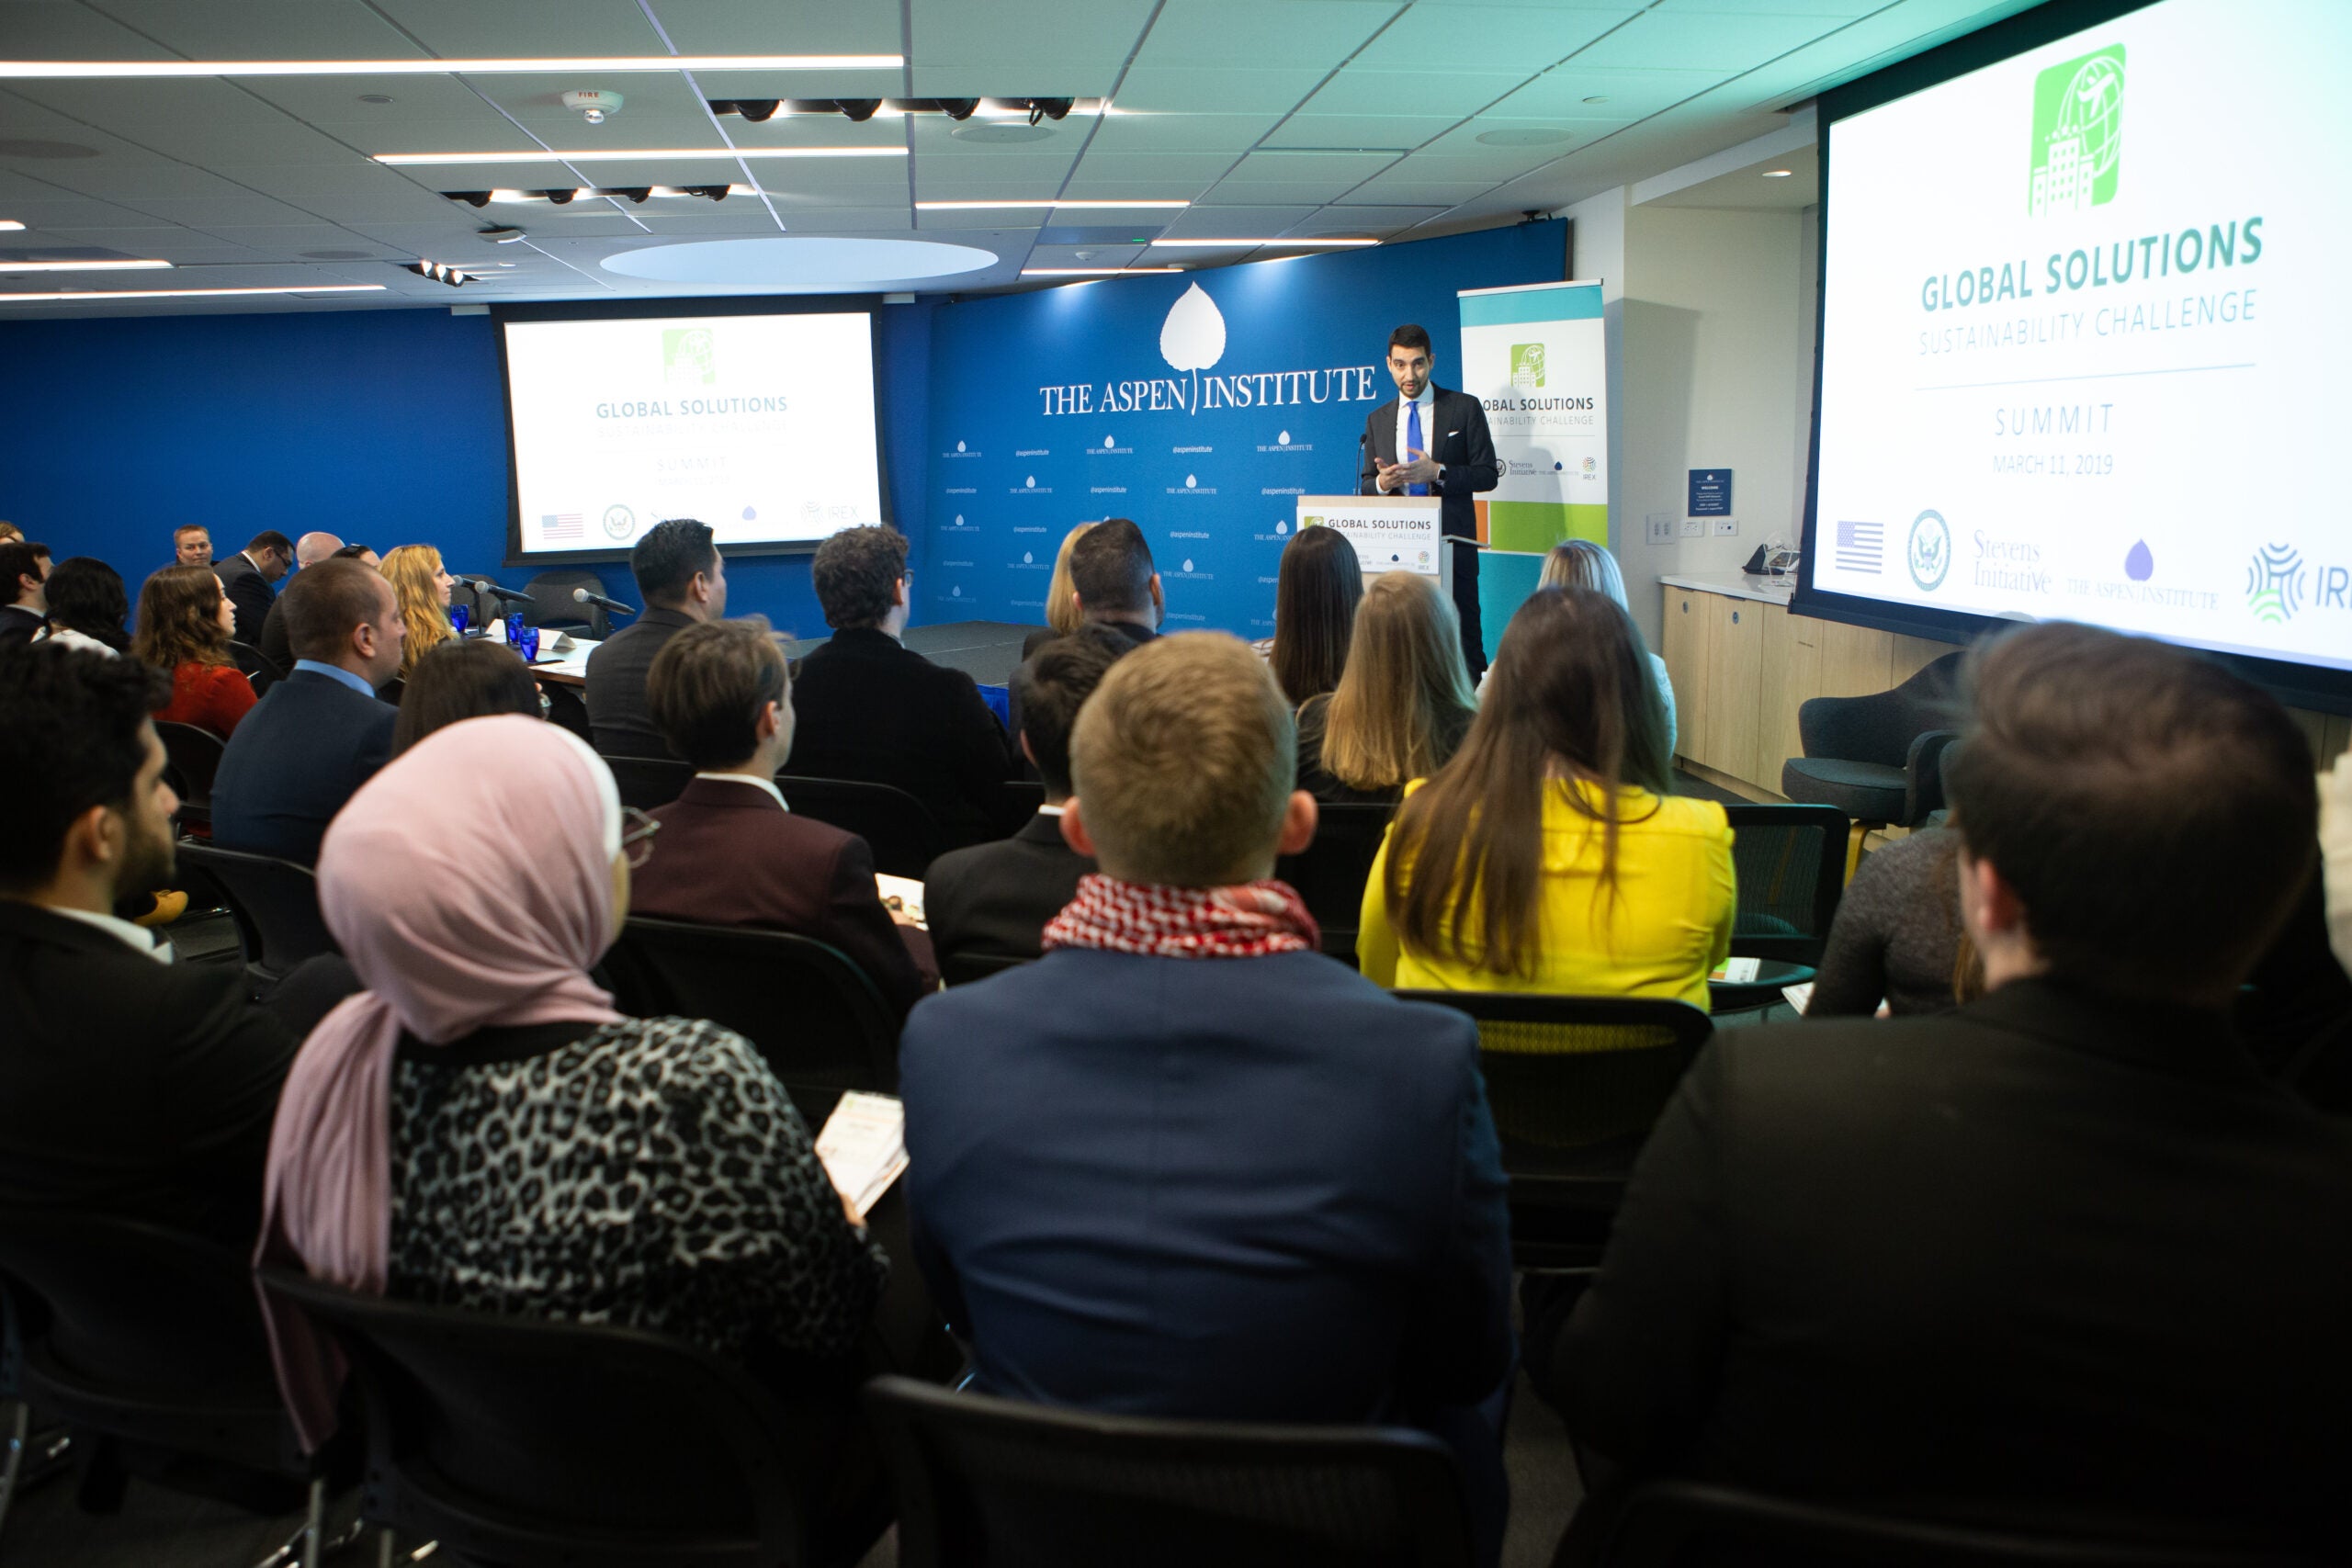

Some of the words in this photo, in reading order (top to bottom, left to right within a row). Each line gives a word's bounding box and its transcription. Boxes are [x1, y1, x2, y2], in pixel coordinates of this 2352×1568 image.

[1921, 259, 2033, 312] GLOBAL
[2045, 216, 2264, 295] SOLUTIONS
[1918, 310, 2085, 356] SUSTAINABILITY
[2095, 288, 2257, 336] CHALLENGE
[1039, 383, 1093, 415] THE
[1099, 378, 1188, 412] ASPEN
[1203, 366, 1377, 409] INSTITUTE
[1482, 399, 1516, 412] OBAL
[1520, 397, 1594, 411] SOLUTIONS
[596, 400, 673, 419] GLOBAL
[680, 396, 788, 416] SOLUTIONS
[1488, 415, 1536, 426] AINABILITY
[1540, 415, 1594, 425] CHALLENGE
[1995, 403, 2114, 436] SUMMIT
[1172, 446, 1213, 454] @aspeninstitute
[1992, 455, 2044, 474] MARCH
[2049, 455, 2070, 478] 11,
[2075, 455, 2114, 475] 2019
[1090, 486, 1127, 494] @aspeninstitute
[1261, 487, 1306, 496] @aspeninstitute
[1329, 519, 1369, 529] GLOBAL
[1372, 519, 1431, 530] SOLUTIONS
[1973, 529, 2041, 563] Stevens
[1973, 560, 2052, 595] Initiative
[2314, 565, 2352, 610] IR
[2067, 577, 2091, 594] THE
[2093, 581, 2138, 602] ASPEN
[2140, 586, 2220, 611] INSTITUTE
